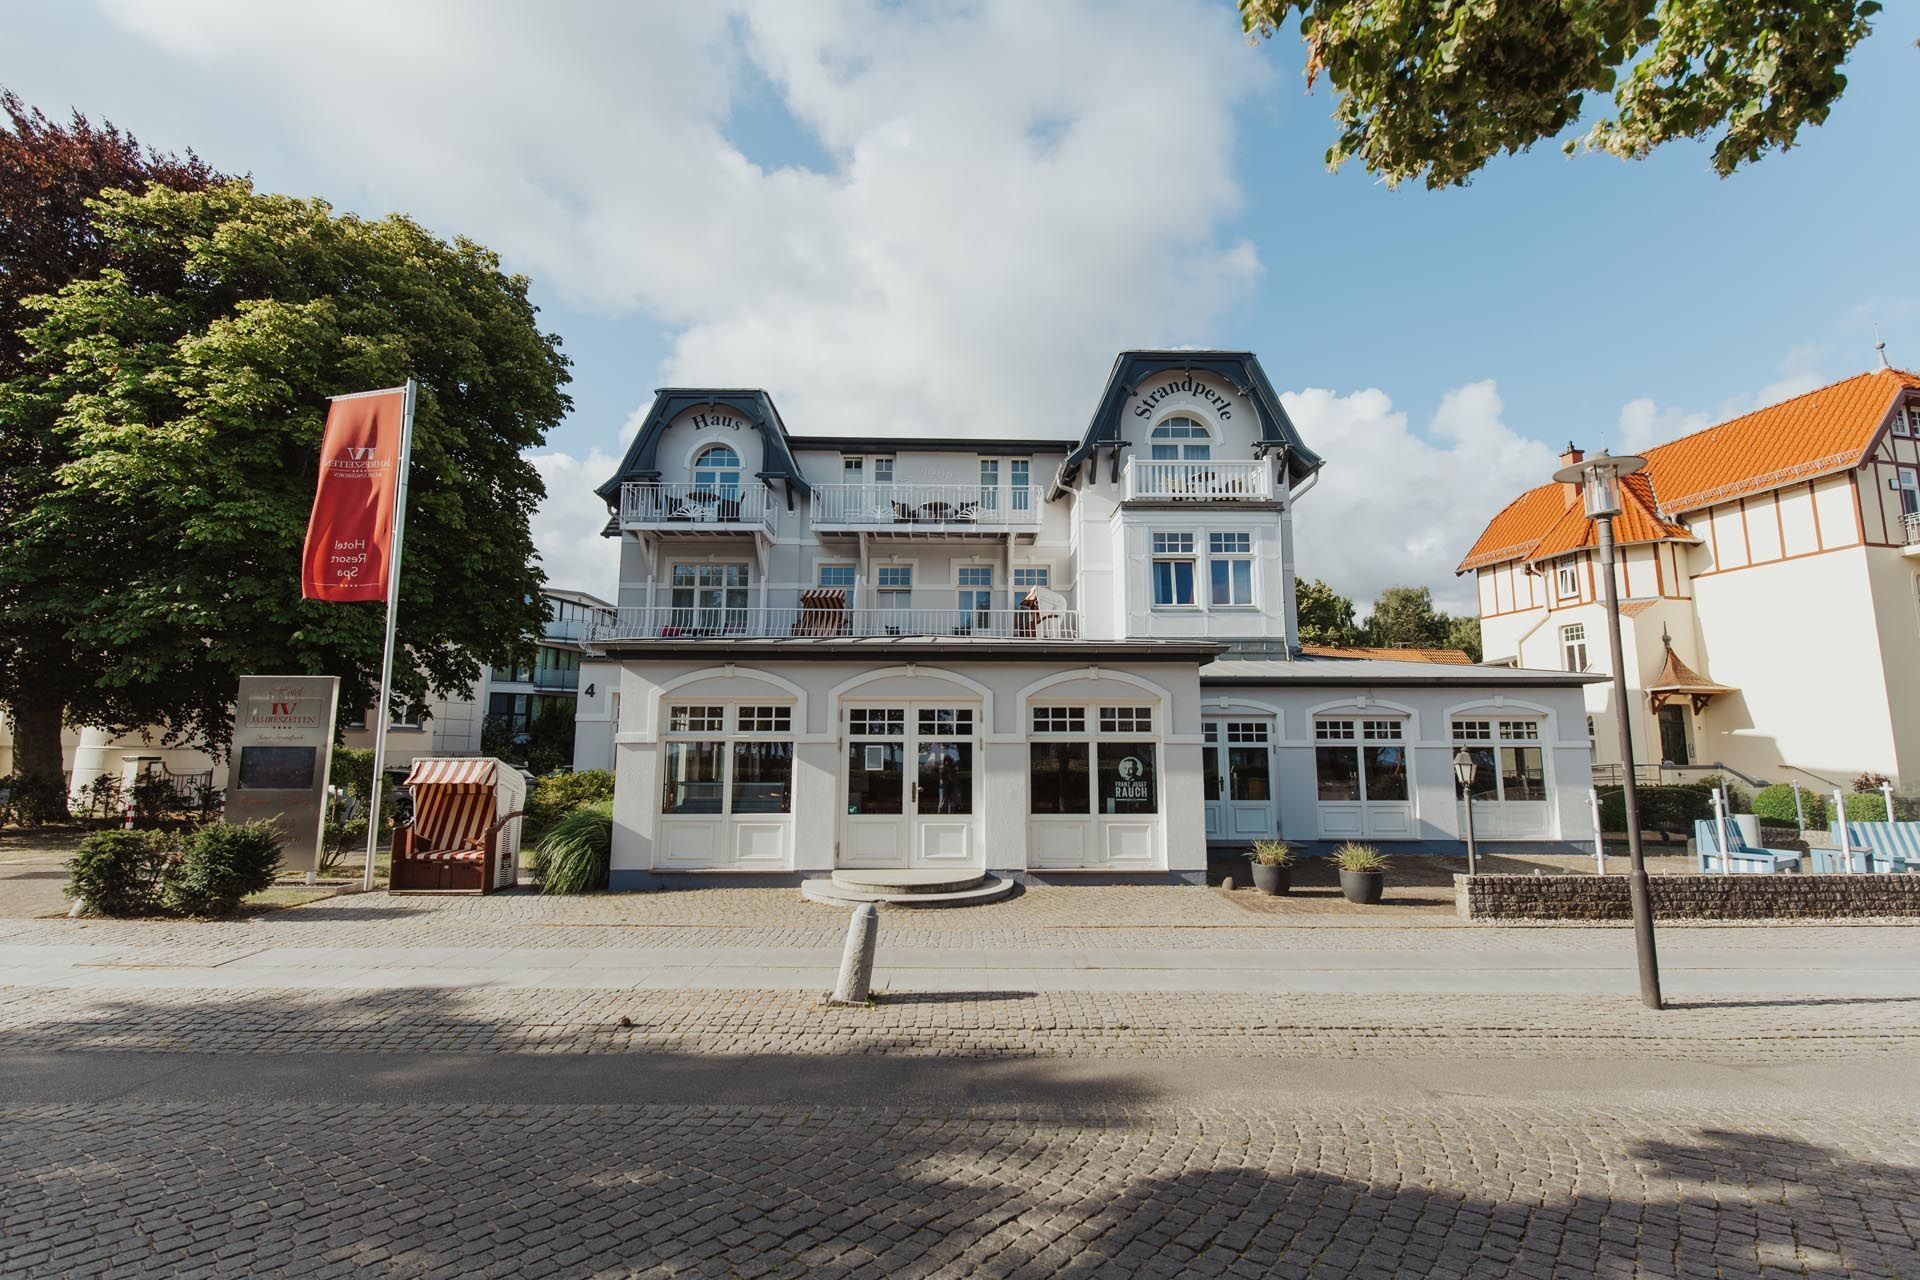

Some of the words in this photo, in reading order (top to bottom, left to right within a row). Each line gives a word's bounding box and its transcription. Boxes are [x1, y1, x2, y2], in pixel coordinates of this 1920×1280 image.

[1135, 377, 1232, 420] Strandperle
[692, 413, 742, 430] Haus
[585, 683, 596, 698] 4
[271, 702, 297, 715] IV
[250, 716, 315, 724] JAHRESZEITEN
[1115, 786, 1148, 798] RAUCH
